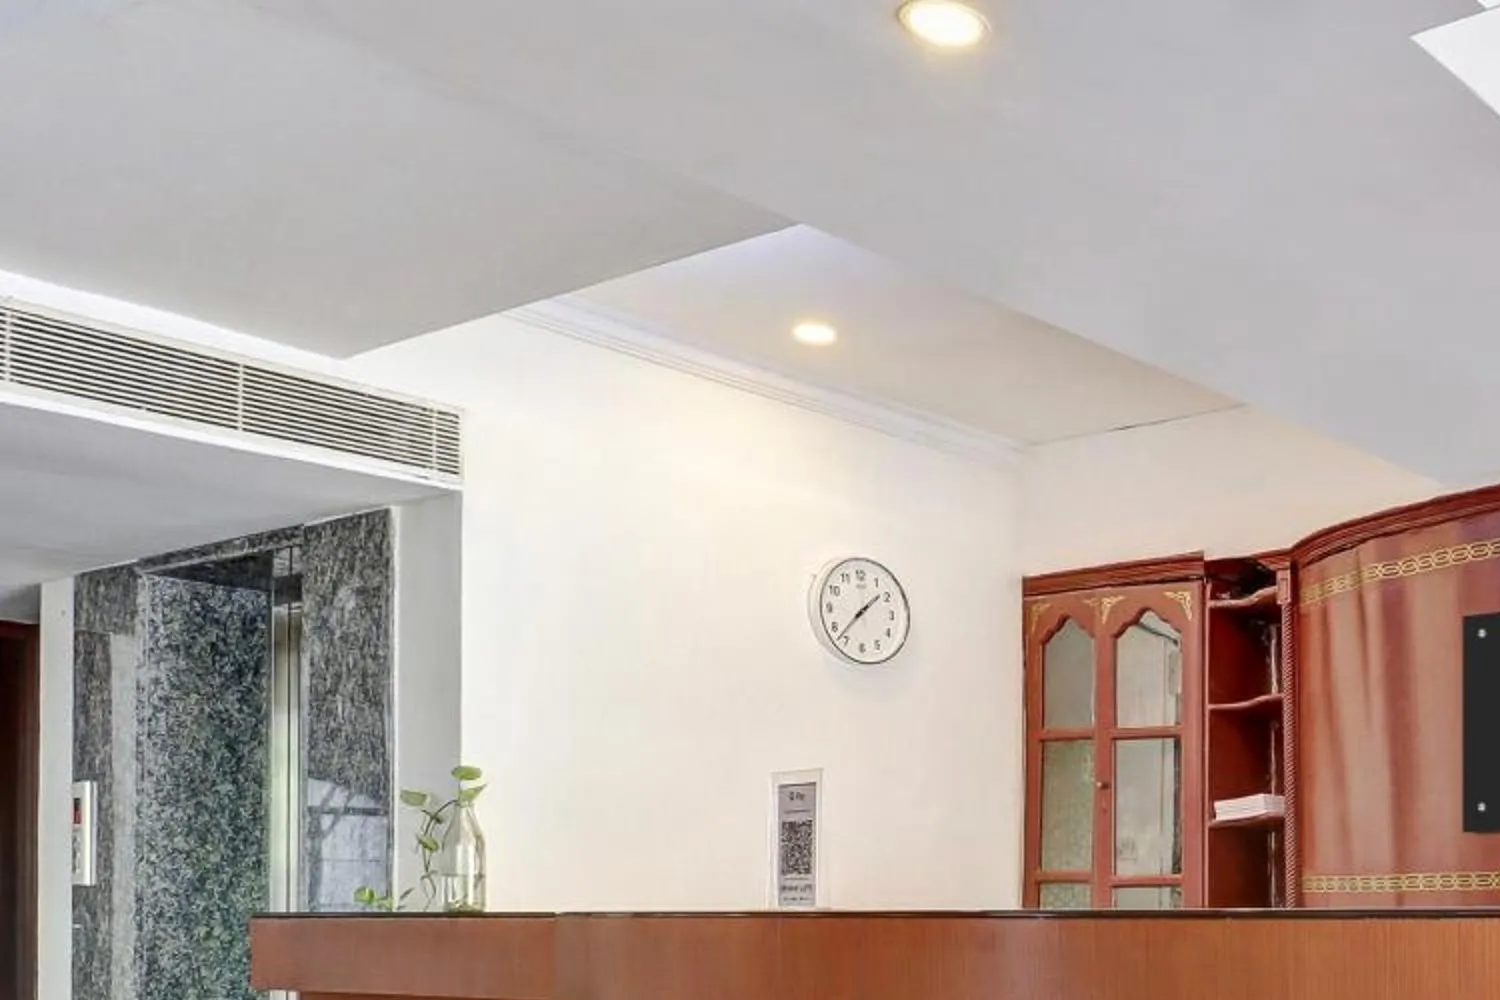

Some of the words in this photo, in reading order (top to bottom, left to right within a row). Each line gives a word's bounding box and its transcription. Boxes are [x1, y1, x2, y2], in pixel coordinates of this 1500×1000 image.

[840, 573, 850, 583] 11
[874, 578, 879, 588] 1
[829, 585, 840, 596] 10
[883, 592, 891, 602] 2
[888, 610, 894, 620] 3
[885, 627, 891, 638] 4
[843, 635, 850, 646] 7
[874, 640, 880, 650] 5
